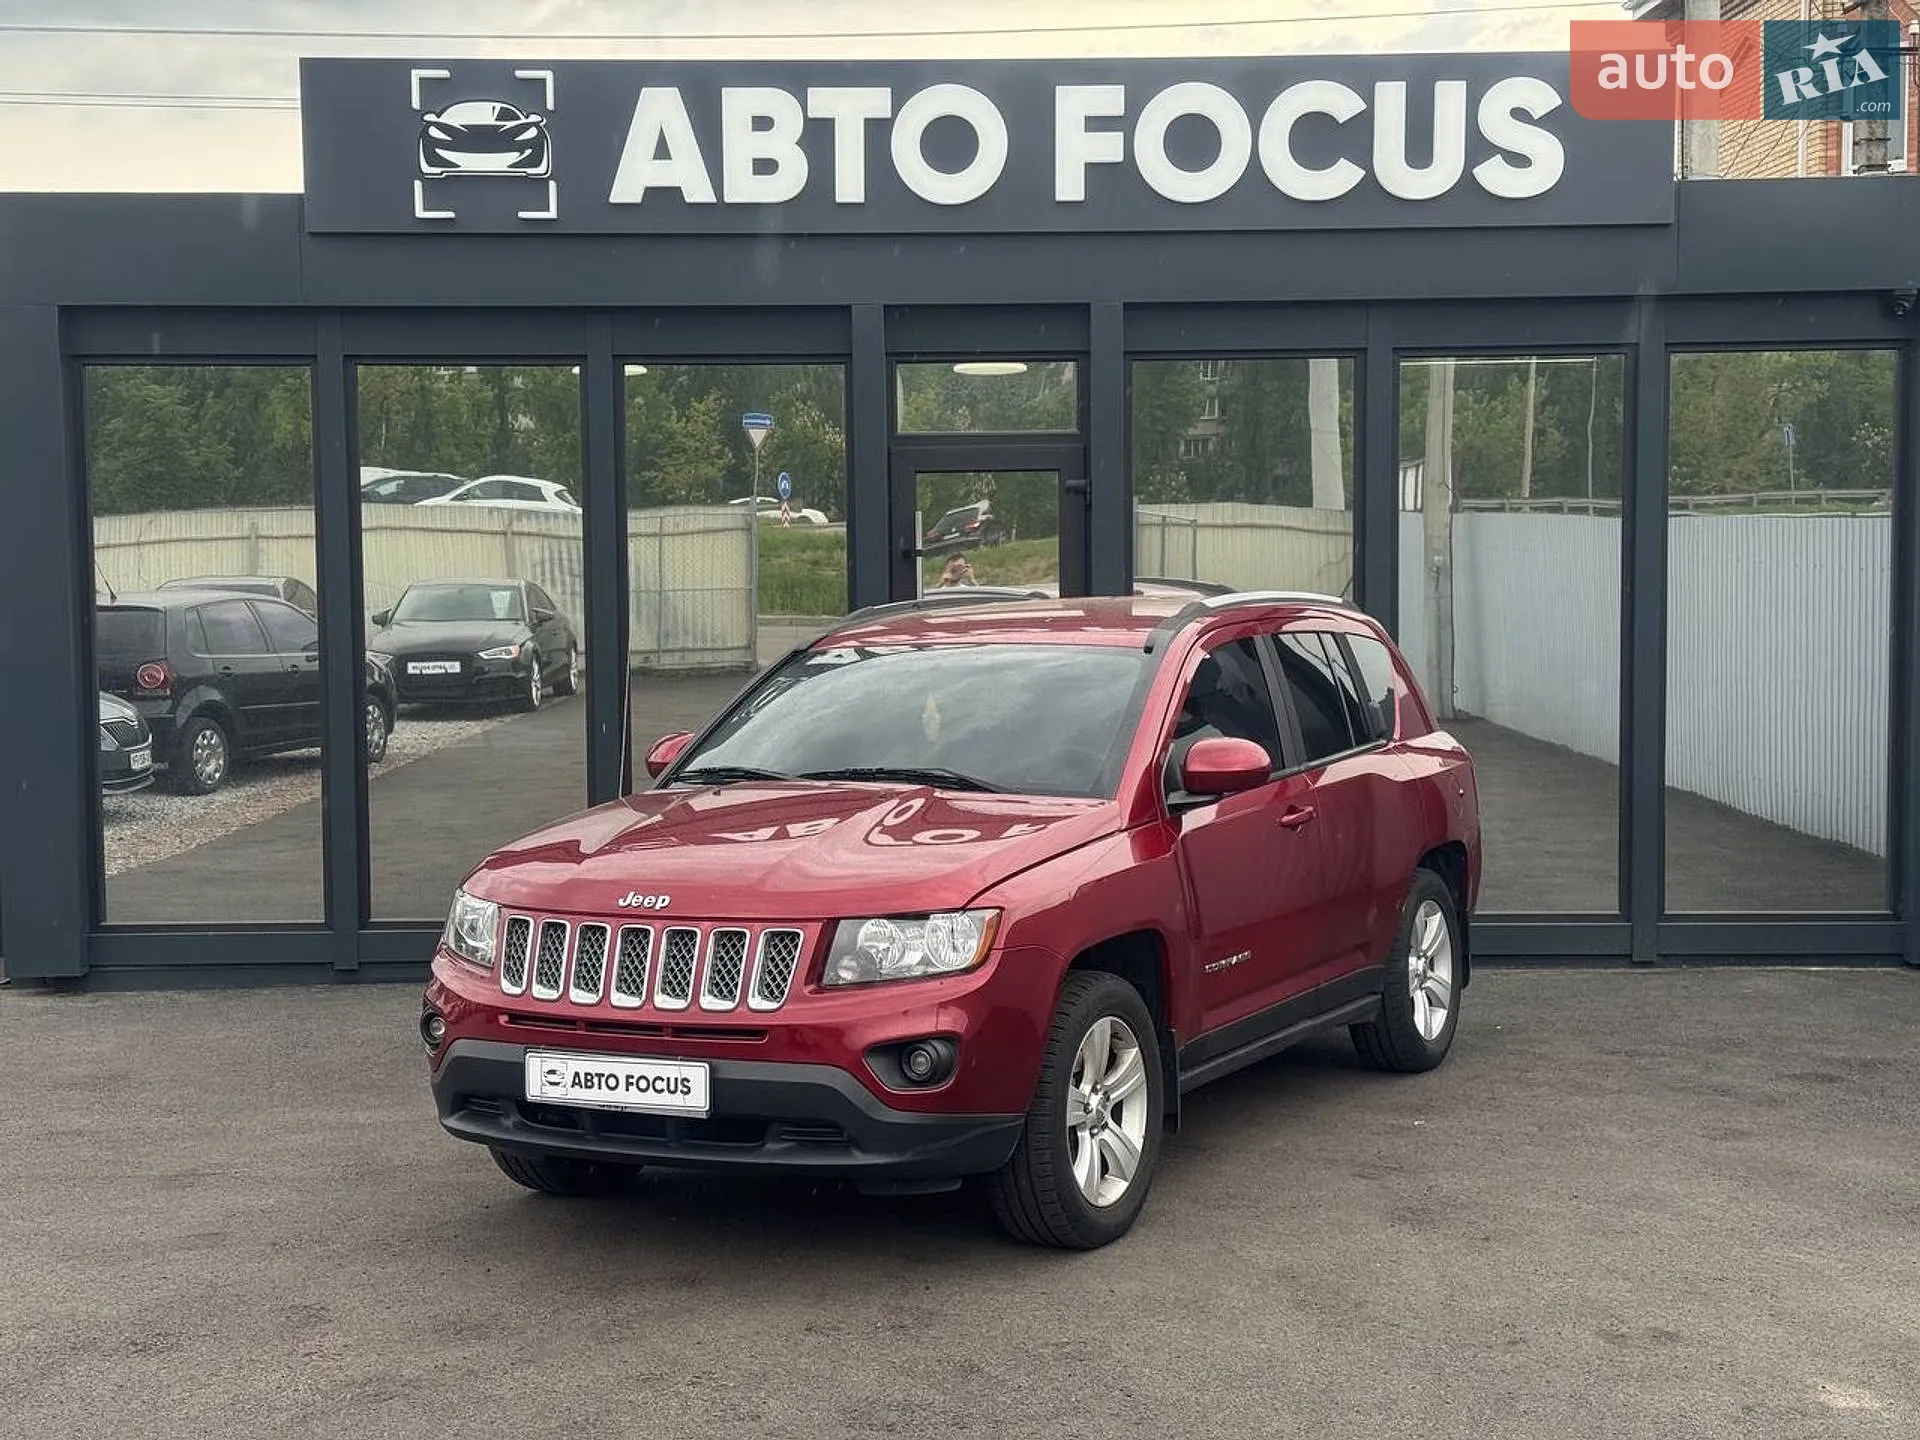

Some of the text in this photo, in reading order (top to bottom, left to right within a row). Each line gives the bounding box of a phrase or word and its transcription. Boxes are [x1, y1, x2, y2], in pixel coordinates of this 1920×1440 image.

[609, 76, 1566, 205] АВТО FOCUS
[618, 891, 671, 910] Jeep
[625, 1074, 692, 1096] FOCUS
